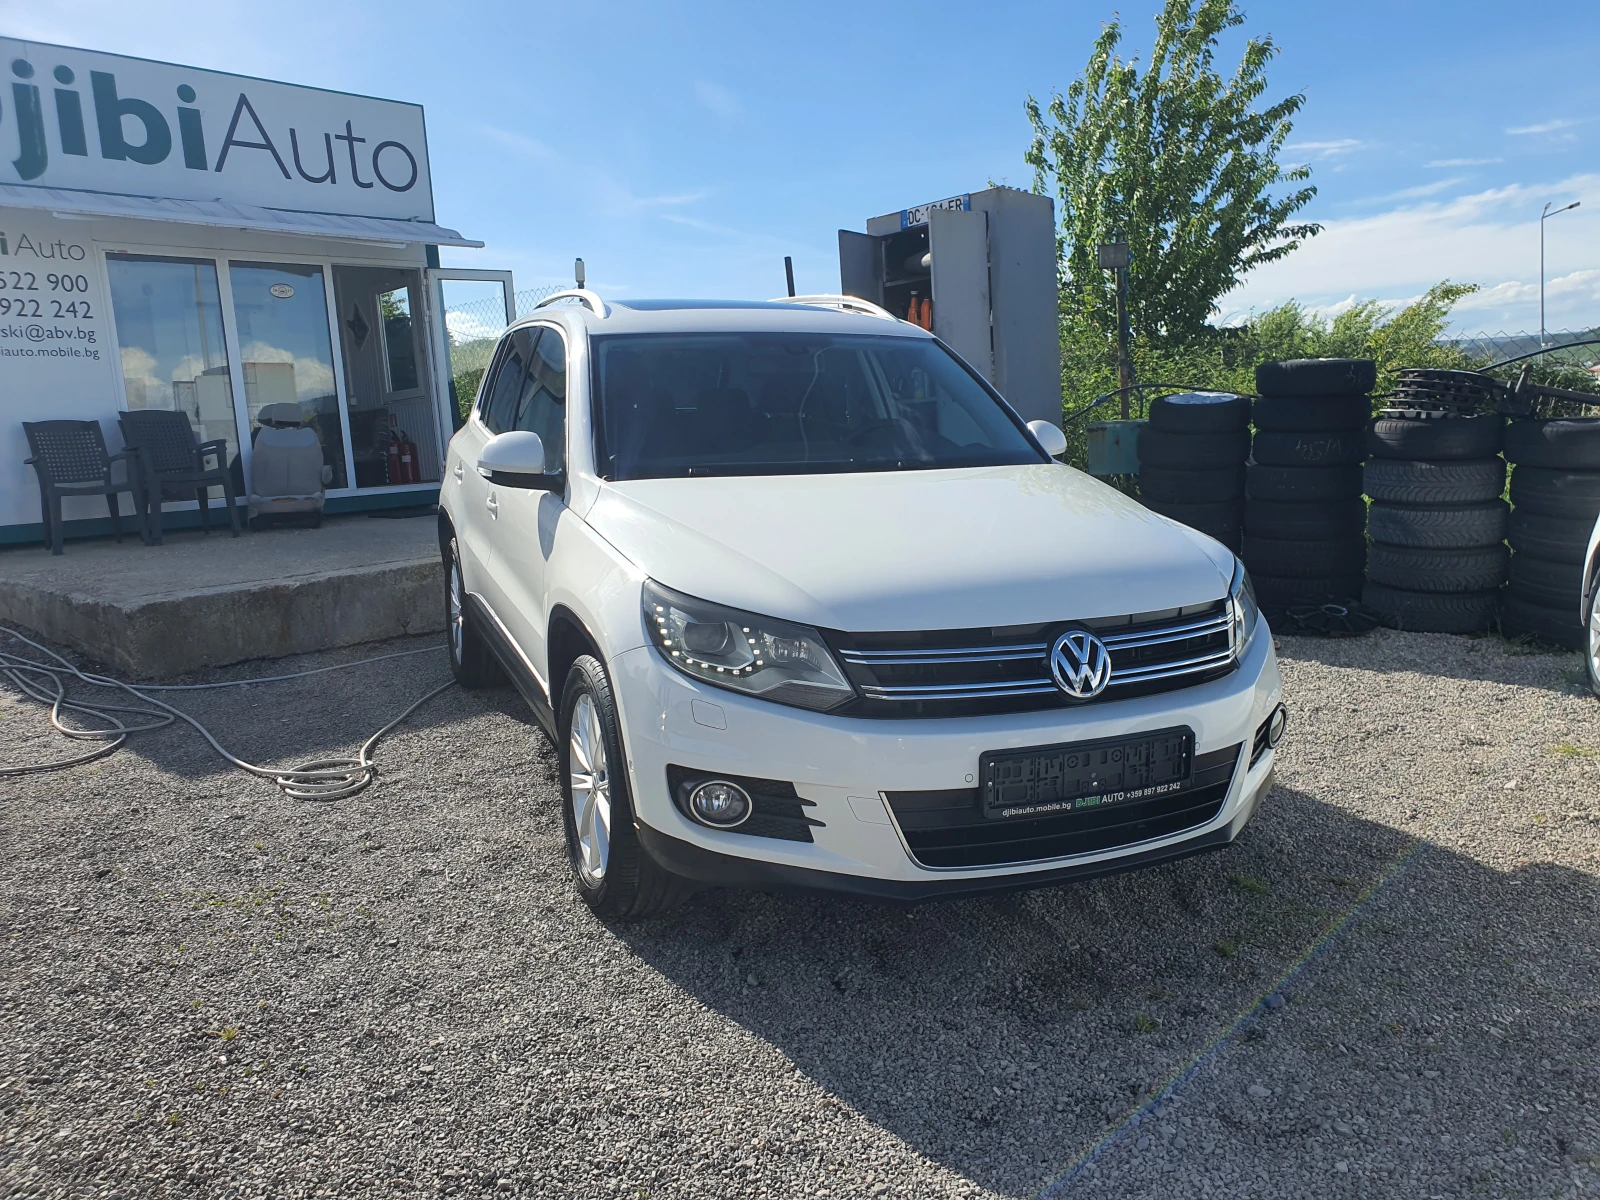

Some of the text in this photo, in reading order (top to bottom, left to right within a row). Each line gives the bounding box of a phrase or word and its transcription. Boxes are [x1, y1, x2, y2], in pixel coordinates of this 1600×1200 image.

[14, 233, 86, 261] Auto
[46, 273, 89, 293] 900
[0, 297, 94, 319] 922 242
[1, 324, 97, 344] ski@abv.bg
[1002, 781, 1181, 818] djibiauto.mobile.bg DJIBI AUTO +359 897 922 242
